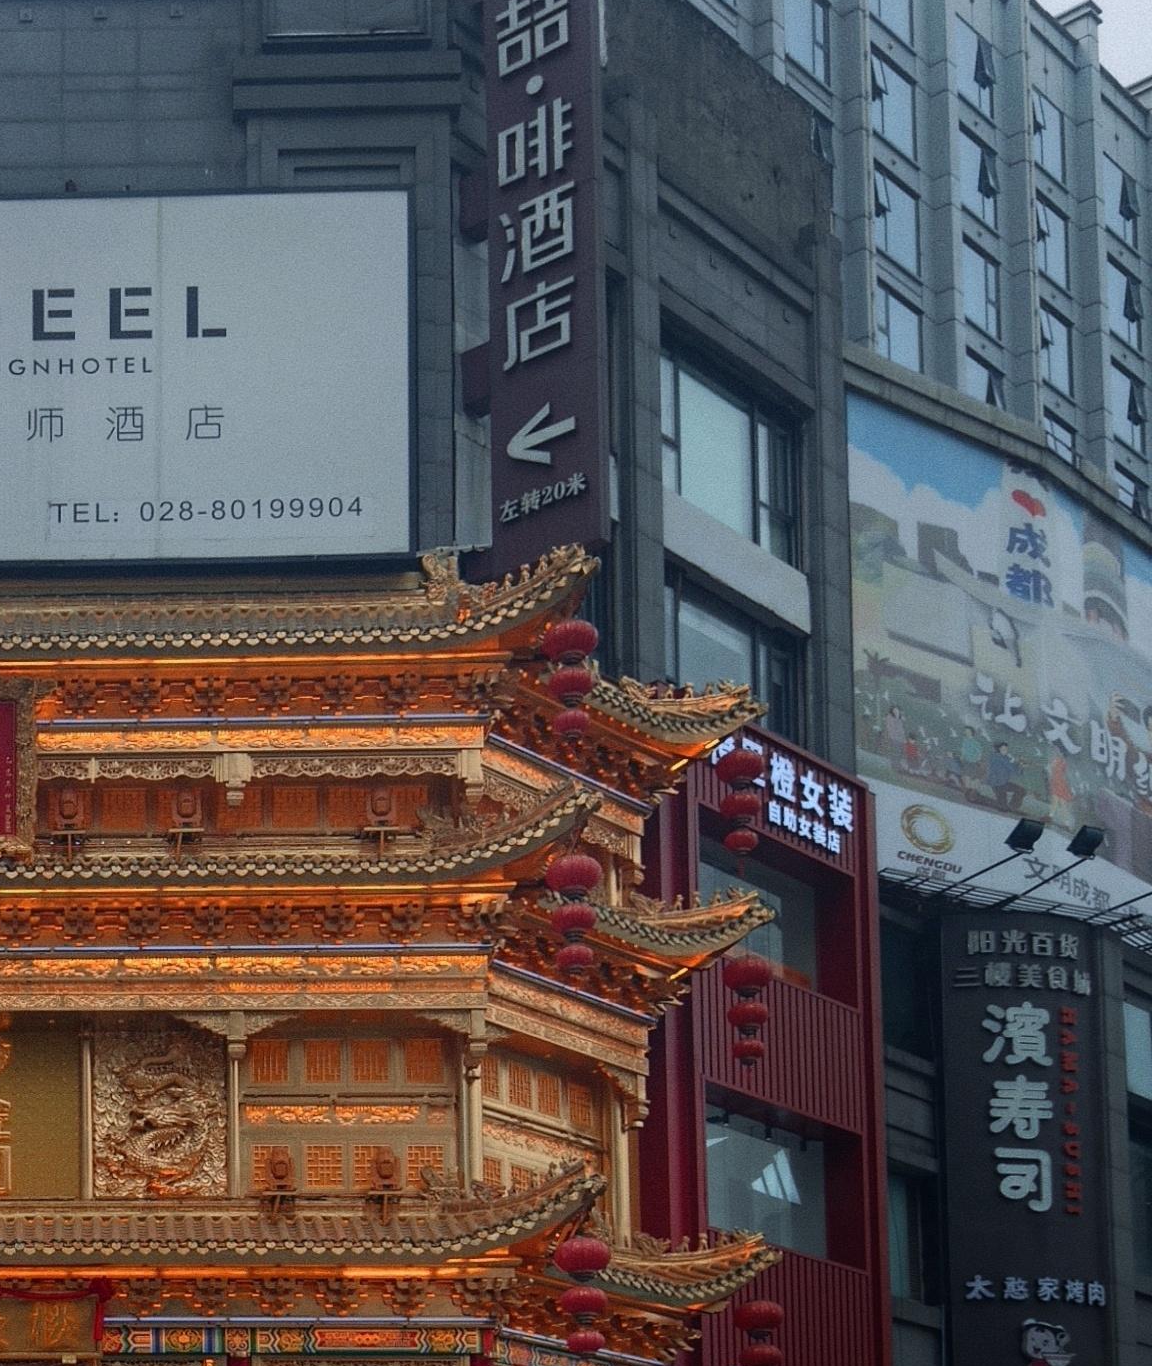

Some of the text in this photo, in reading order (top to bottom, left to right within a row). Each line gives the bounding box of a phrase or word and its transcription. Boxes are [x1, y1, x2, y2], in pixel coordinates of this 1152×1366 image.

[138, 494, 364, 524] 028-80199904
[498, 474, 587, 524] 左转20米
[1005, 520, 1055, 608] 成都
[897, 850, 963, 874] CHENGDU
[967, 929, 1079, 961] 阳光百货
